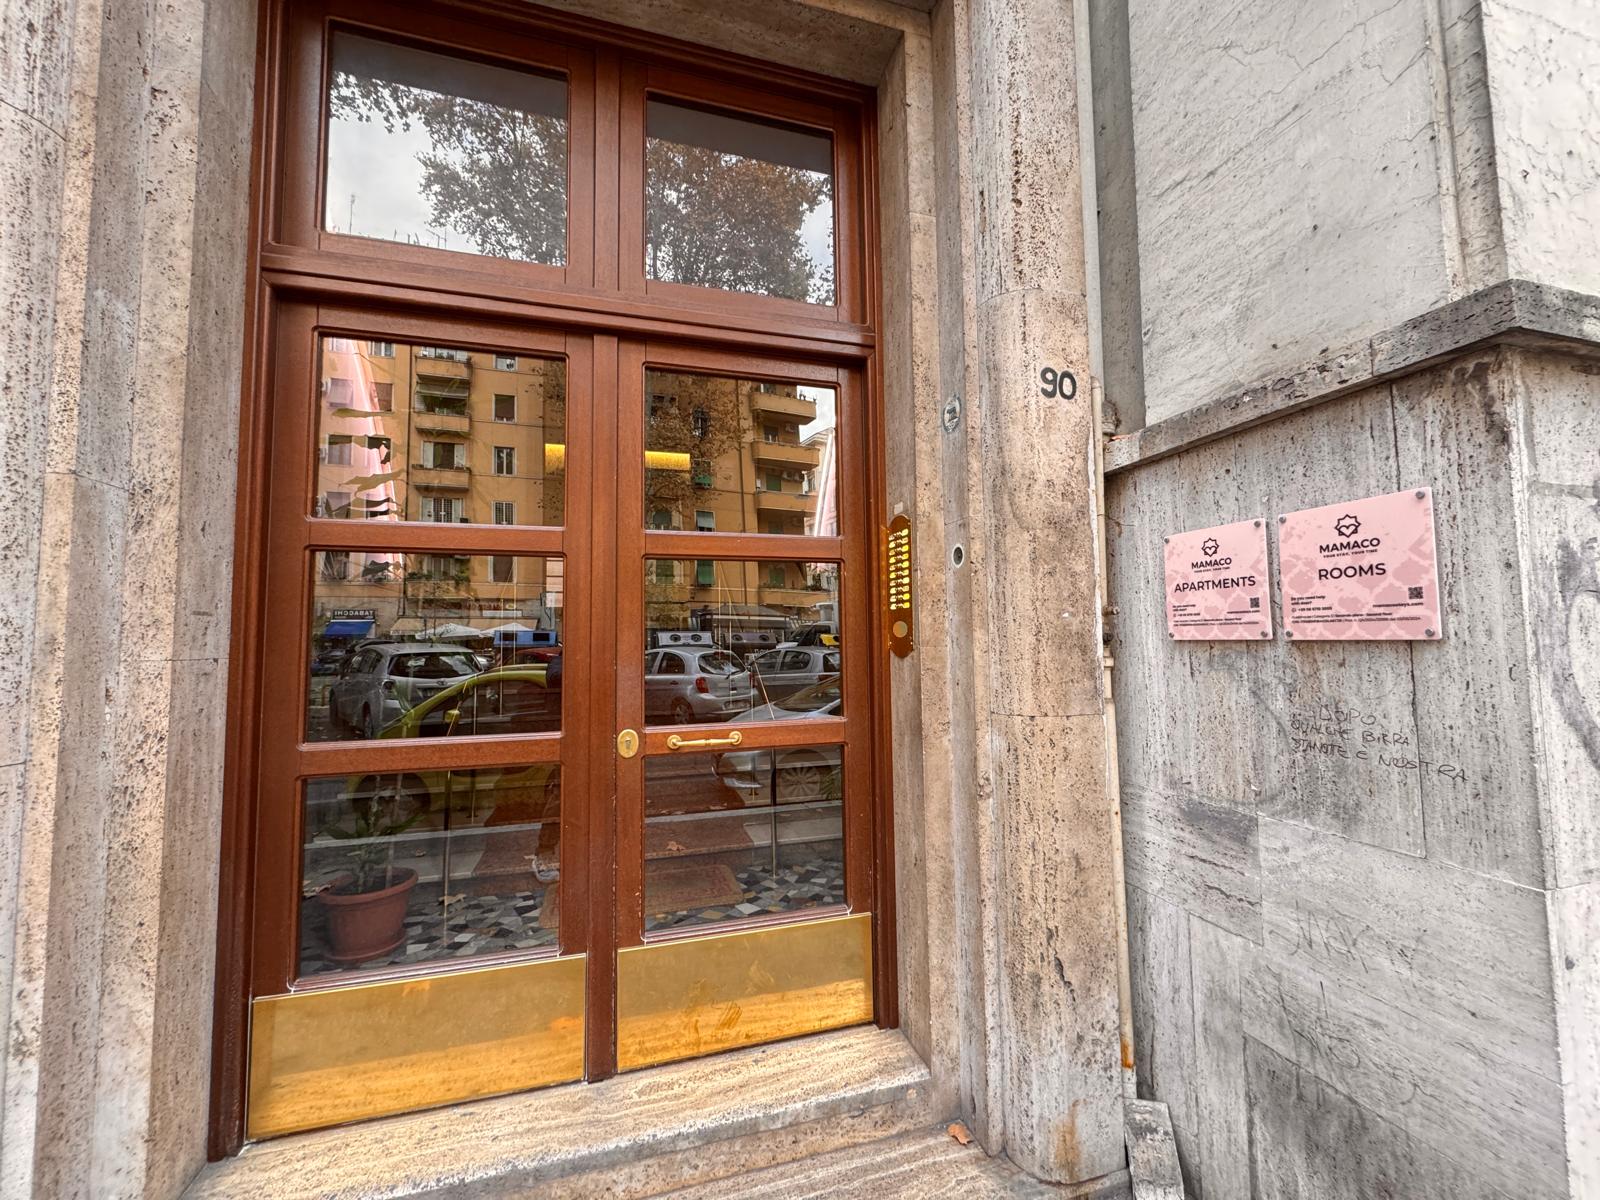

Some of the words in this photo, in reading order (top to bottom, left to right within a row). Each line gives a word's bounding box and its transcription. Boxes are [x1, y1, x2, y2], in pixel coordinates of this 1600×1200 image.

[1040, 367, 1077, 400] 90
[1319, 537, 1381, 554] MAMACO
[1191, 557, 1232, 569] MAMACO
[1318, 562, 1387, 580] ROOMS
[1174, 575, 1256, 593] APARTMENTS
[1319, 705, 1376, 725] DOPO
[1378, 754, 1468, 782] NOSTRA
